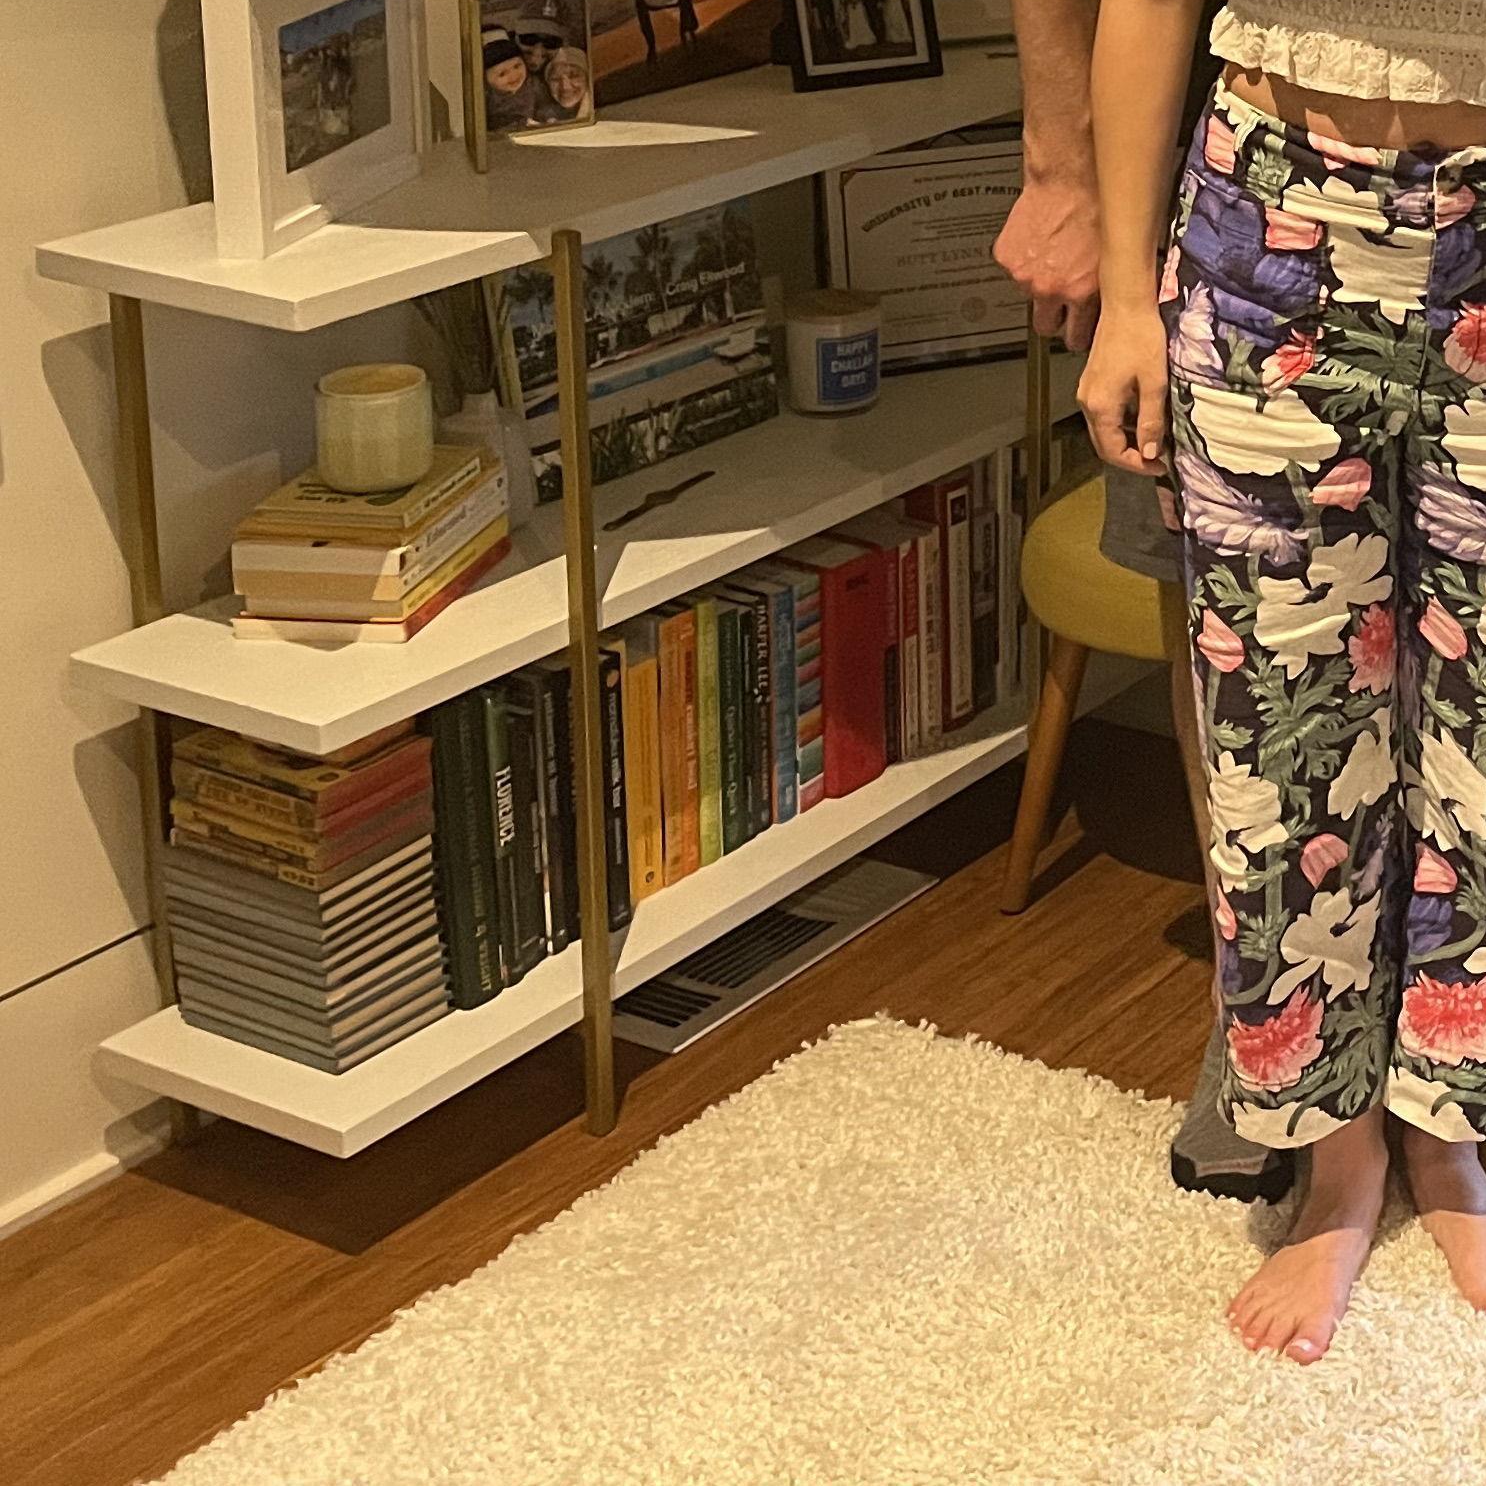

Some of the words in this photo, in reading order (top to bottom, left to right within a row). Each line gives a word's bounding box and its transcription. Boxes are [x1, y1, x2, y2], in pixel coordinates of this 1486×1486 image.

[861, 195, 932, 233] UNIVERSITY
[933, 189, 949, 202] OF
[952, 185, 980, 199] BEST
[665, 278, 699, 297] Craig
[700, 261, 745, 286] Ellwood
[756, 603, 768, 661] HARPER
[757, 667, 769, 691] LEE
[495, 764, 516, 848] FLORENCE
